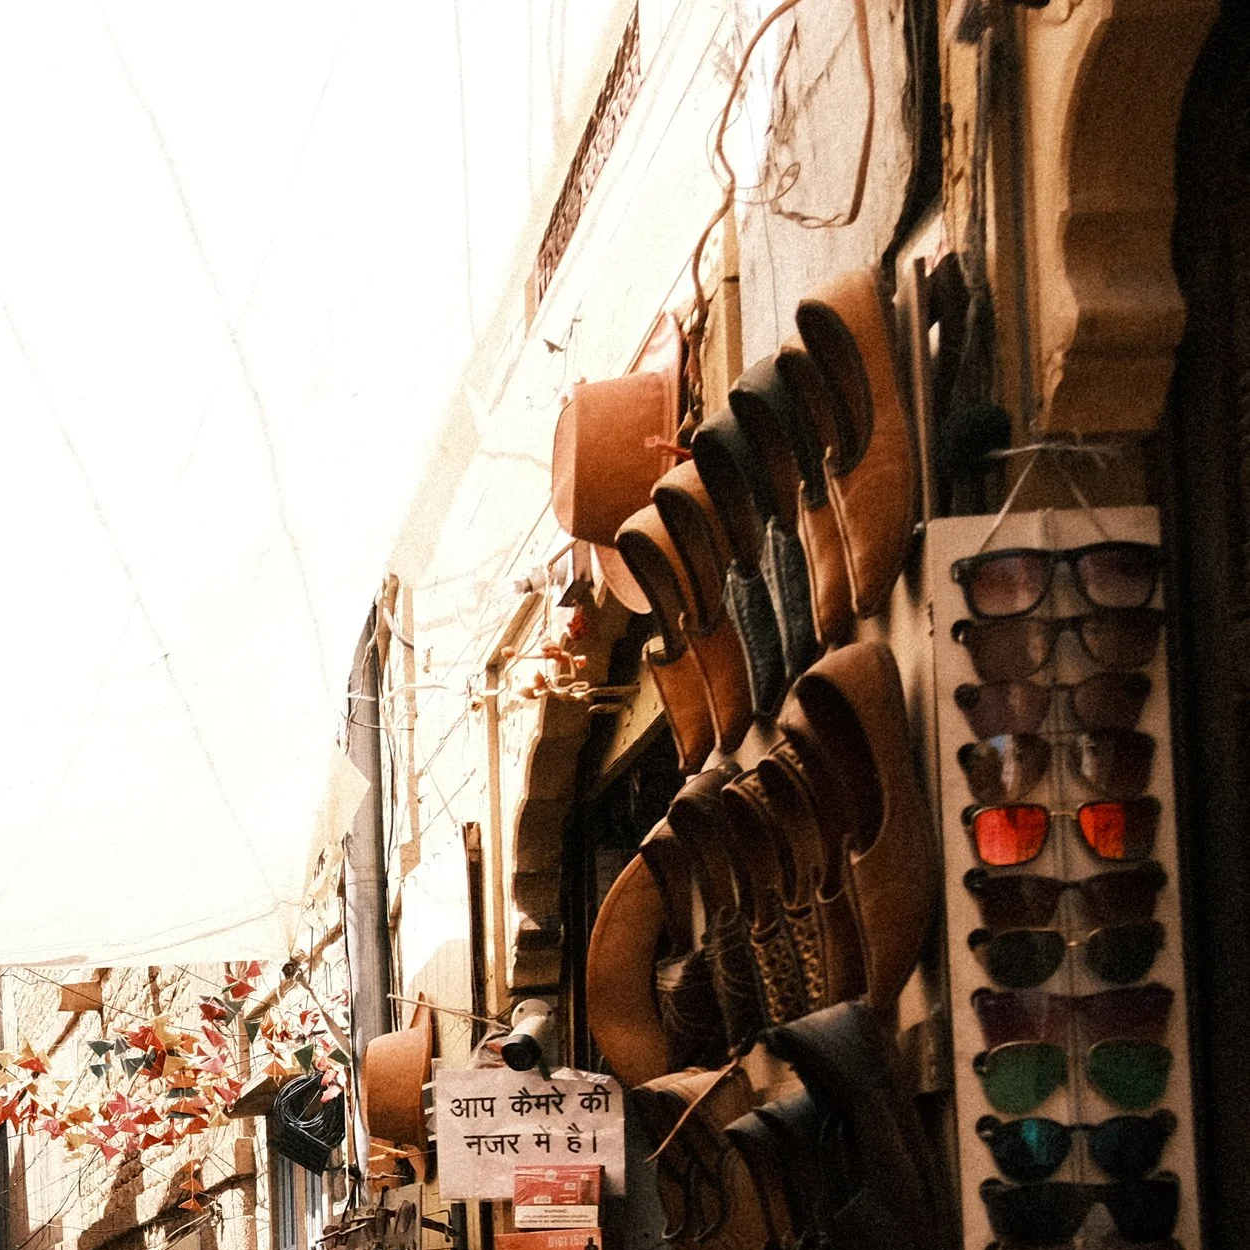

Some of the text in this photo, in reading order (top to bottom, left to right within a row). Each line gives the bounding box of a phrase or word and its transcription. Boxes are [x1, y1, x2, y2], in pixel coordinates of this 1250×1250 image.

[450, 1084, 613, 1118] आप कैमरे की
[464, 1133, 521, 1156] नजर
